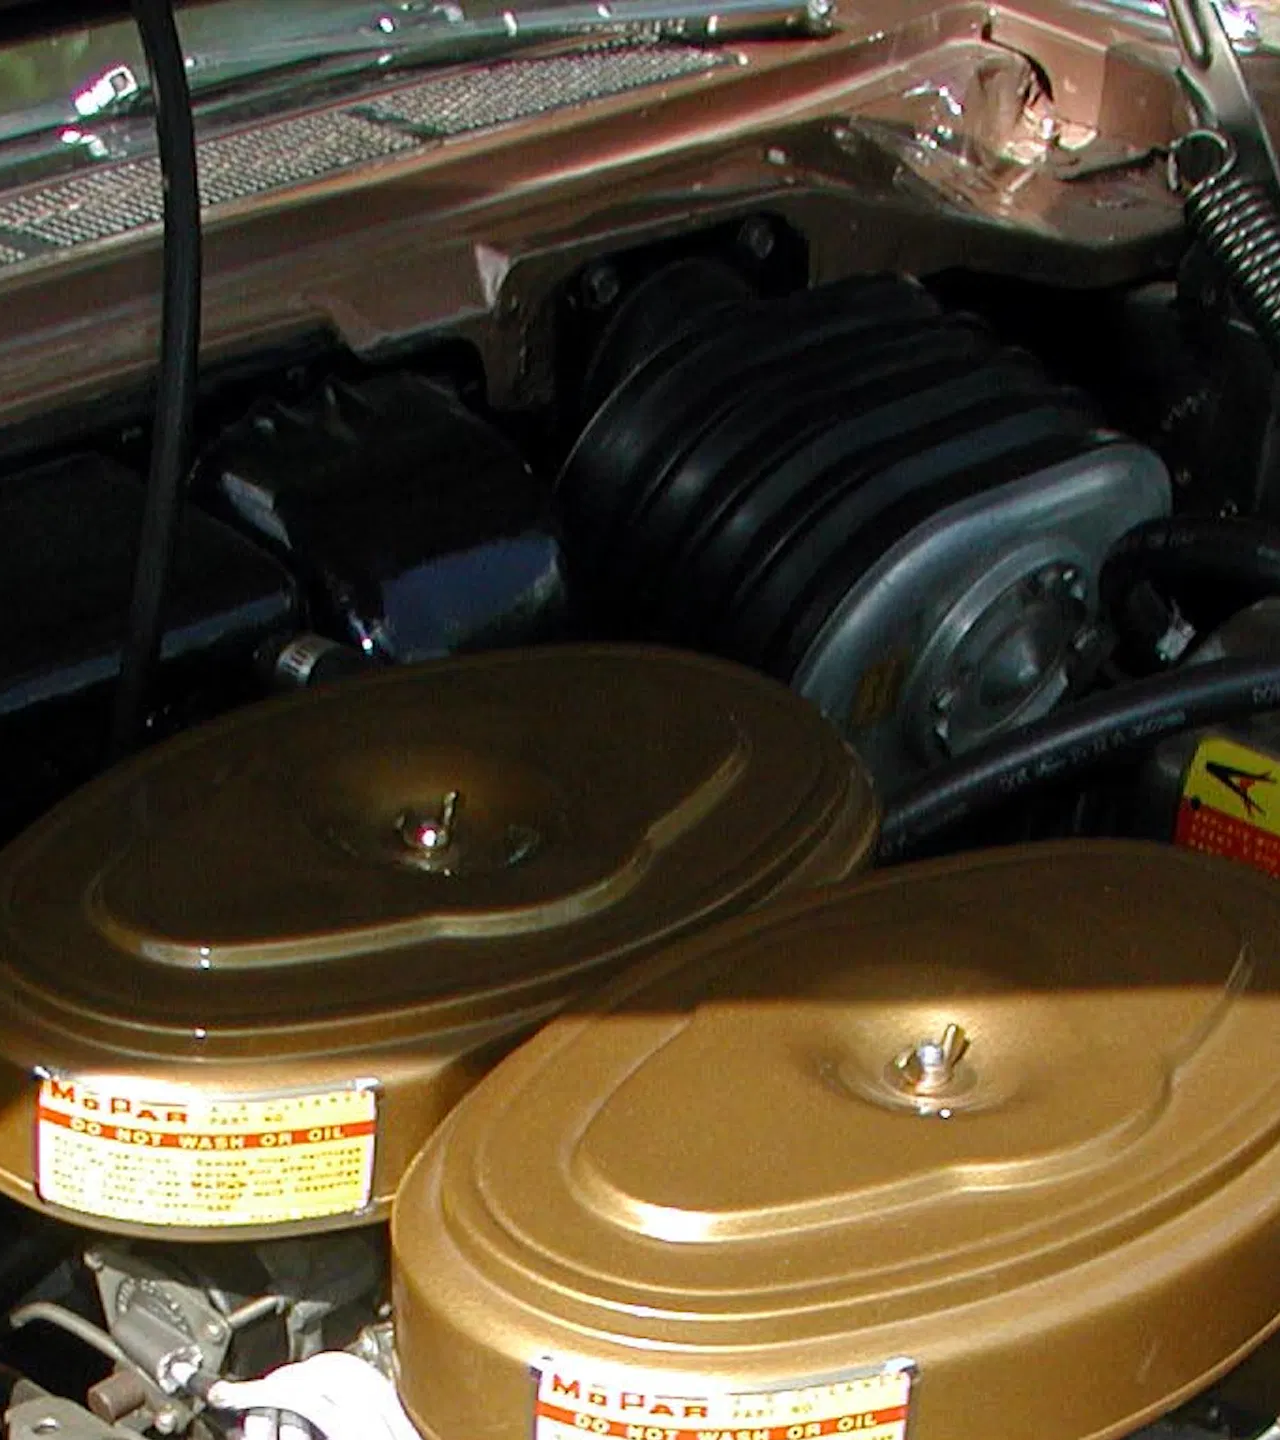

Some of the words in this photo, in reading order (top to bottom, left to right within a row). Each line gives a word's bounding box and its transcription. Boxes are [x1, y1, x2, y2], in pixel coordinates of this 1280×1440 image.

[69, 1117, 102, 1137] DO
[116, 1127, 164, 1147] NOT
[177, 1134, 245, 1151] WASH
[259, 1131, 293, 1148] OR
[307, 1126, 345, 1142] OIL
[575, 1413, 610, 1434] DO
[786, 1421, 822, 1439] OR
[837, 1414, 879, 1433] OIL
